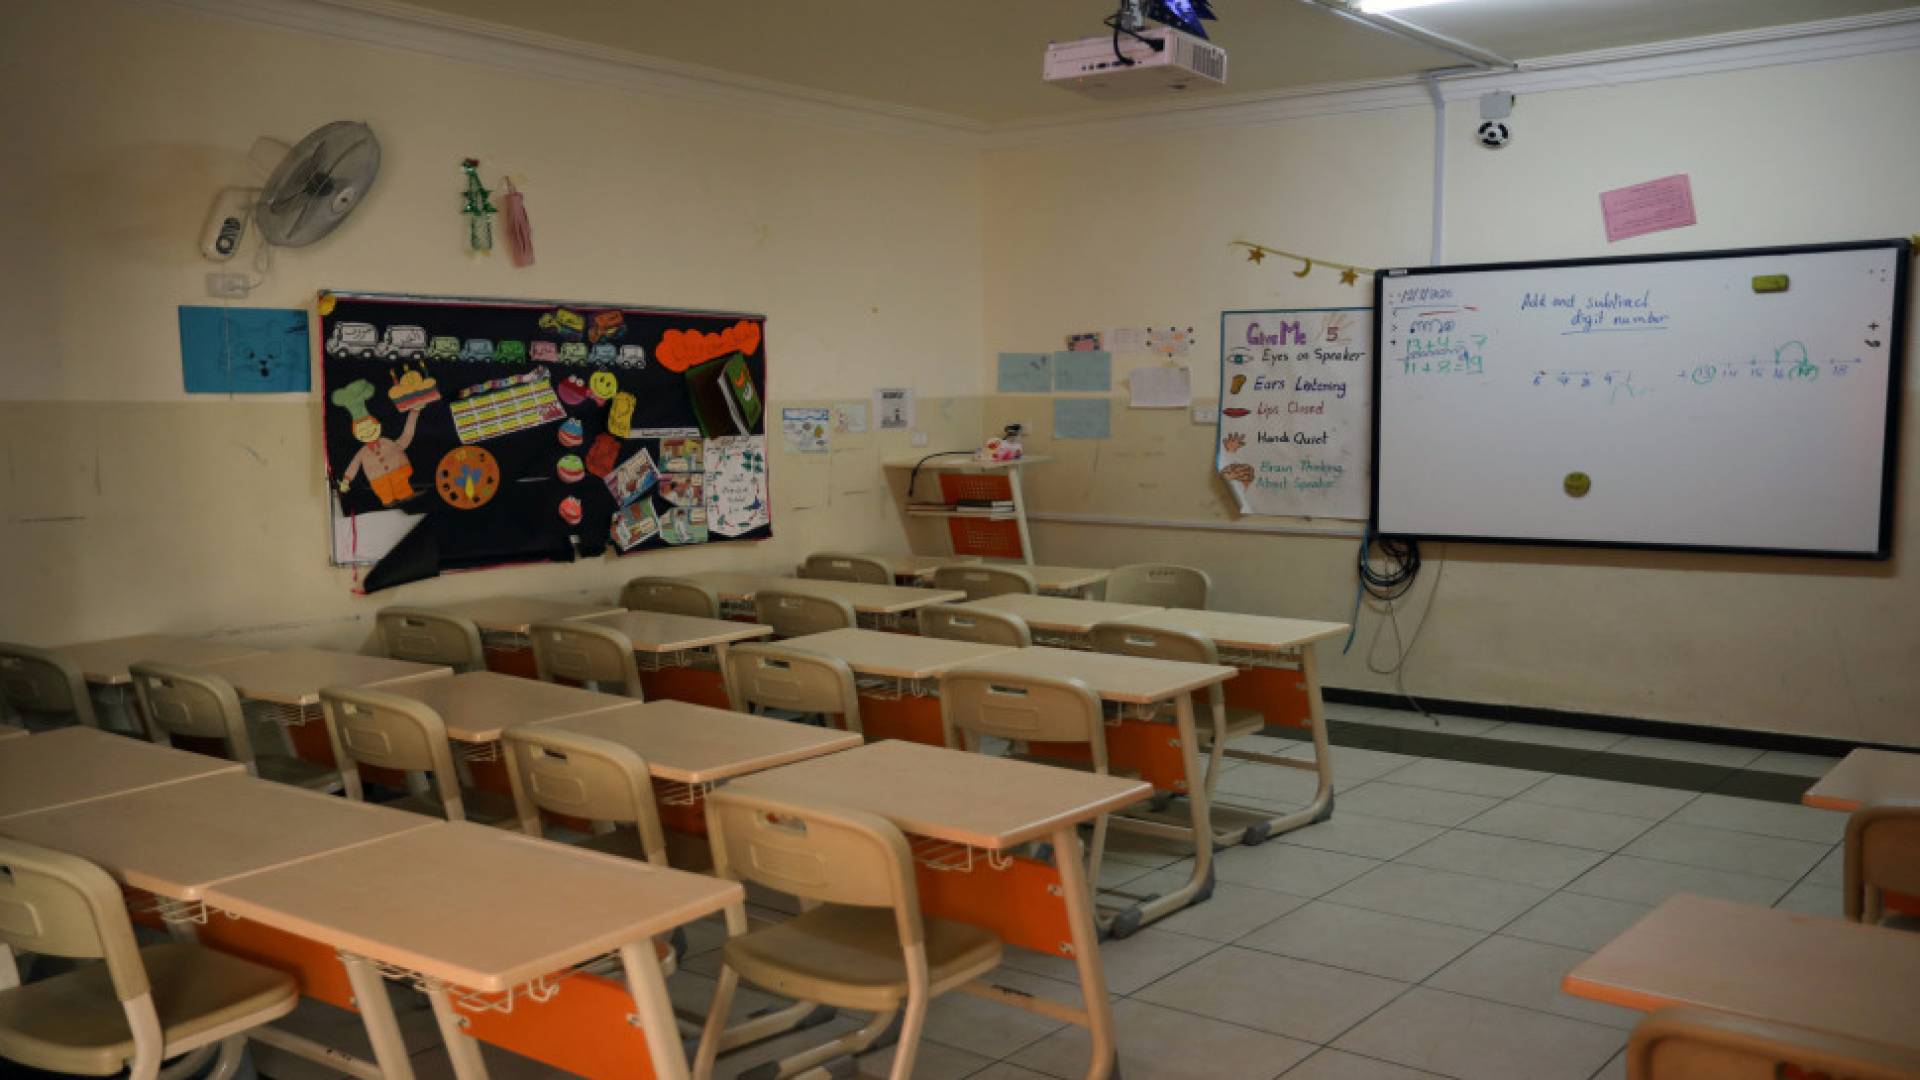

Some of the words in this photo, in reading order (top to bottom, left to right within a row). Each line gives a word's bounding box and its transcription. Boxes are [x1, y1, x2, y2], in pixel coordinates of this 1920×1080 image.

[1522, 292, 1546, 310] Add
[1552, 294, 1575, 309] and
[1570, 310, 1606, 332] digit
[1613, 313, 1670, 326] number
[1326, 325, 1339, 342] 5
[1261, 348, 1289, 367] Eyes
[1296, 352, 1308, 361] on
[1314, 347, 1366, 364] Speaker
[1253, 376, 1285, 391] Ears
[1295, 375, 1347, 399] Listening
[1256, 402, 1280, 419] Lips
[1287, 400, 1325, 415] Closed
[1293, 431, 1329, 445] Quiet
[1259, 459, 1293, 473] Brain
[1256, 476, 1288, 489] About
